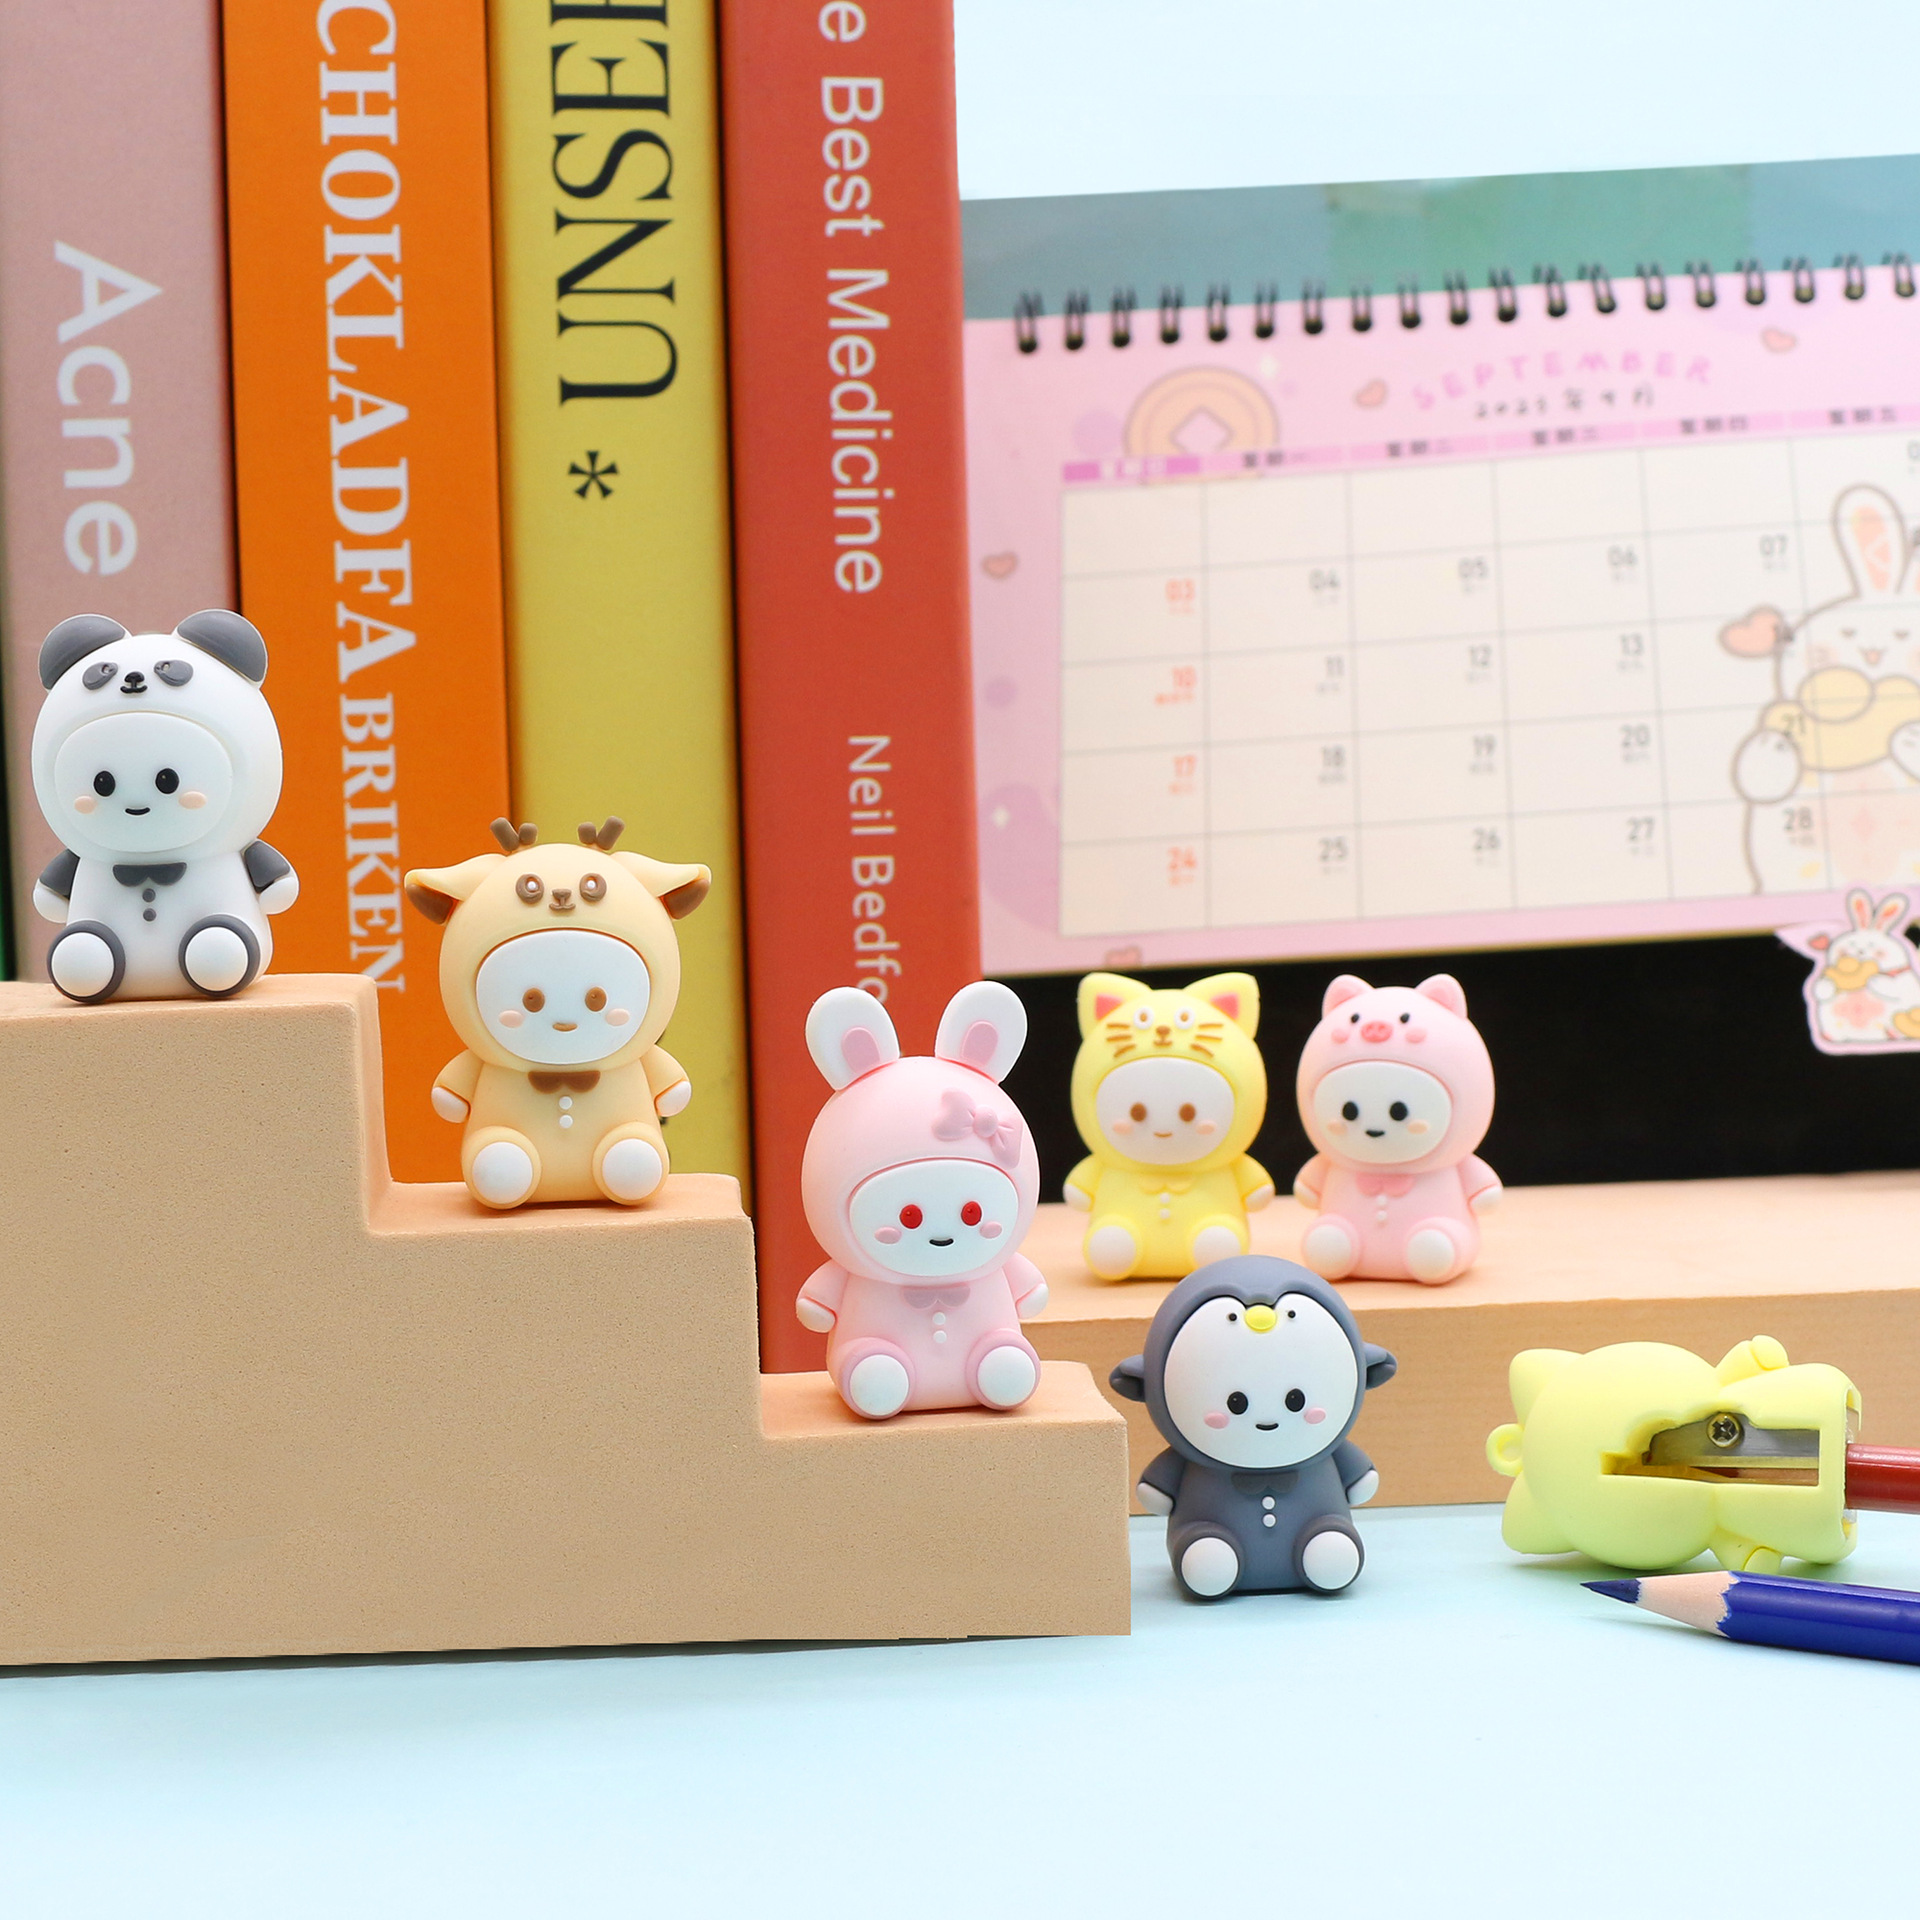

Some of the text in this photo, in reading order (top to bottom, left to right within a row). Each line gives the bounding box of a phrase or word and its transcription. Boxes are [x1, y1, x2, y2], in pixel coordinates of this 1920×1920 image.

[821, 77, 884, 237] Best
[1412, 352, 1710, 410] SEPTEMBER
[54, 240, 163, 576] Acne
[826, 269, 895, 593] Medicine
[1607, 545, 1638, 568] 06
[1759, 535, 1788, 558] 07
[1459, 556, 1489, 581] 05
[1309, 569, 1340, 594] 04
[1468, 644, 1491, 668] 12
[1619, 634, 1643, 656] 13
[1325, 656, 1344, 678] 11
[1473, 735, 1496, 758] 19
[1621, 725, 1651, 749] 20
[1322, 745, 1344, 770] 18
[848, 735, 895, 836] Neil
[1627, 818, 1656, 842] 27
[1783, 807, 1813, 832] 28
[1318, 838, 1348, 863] 25
[1473, 828, 1501, 853] 26
[1167, 846, 1197, 871] 24
